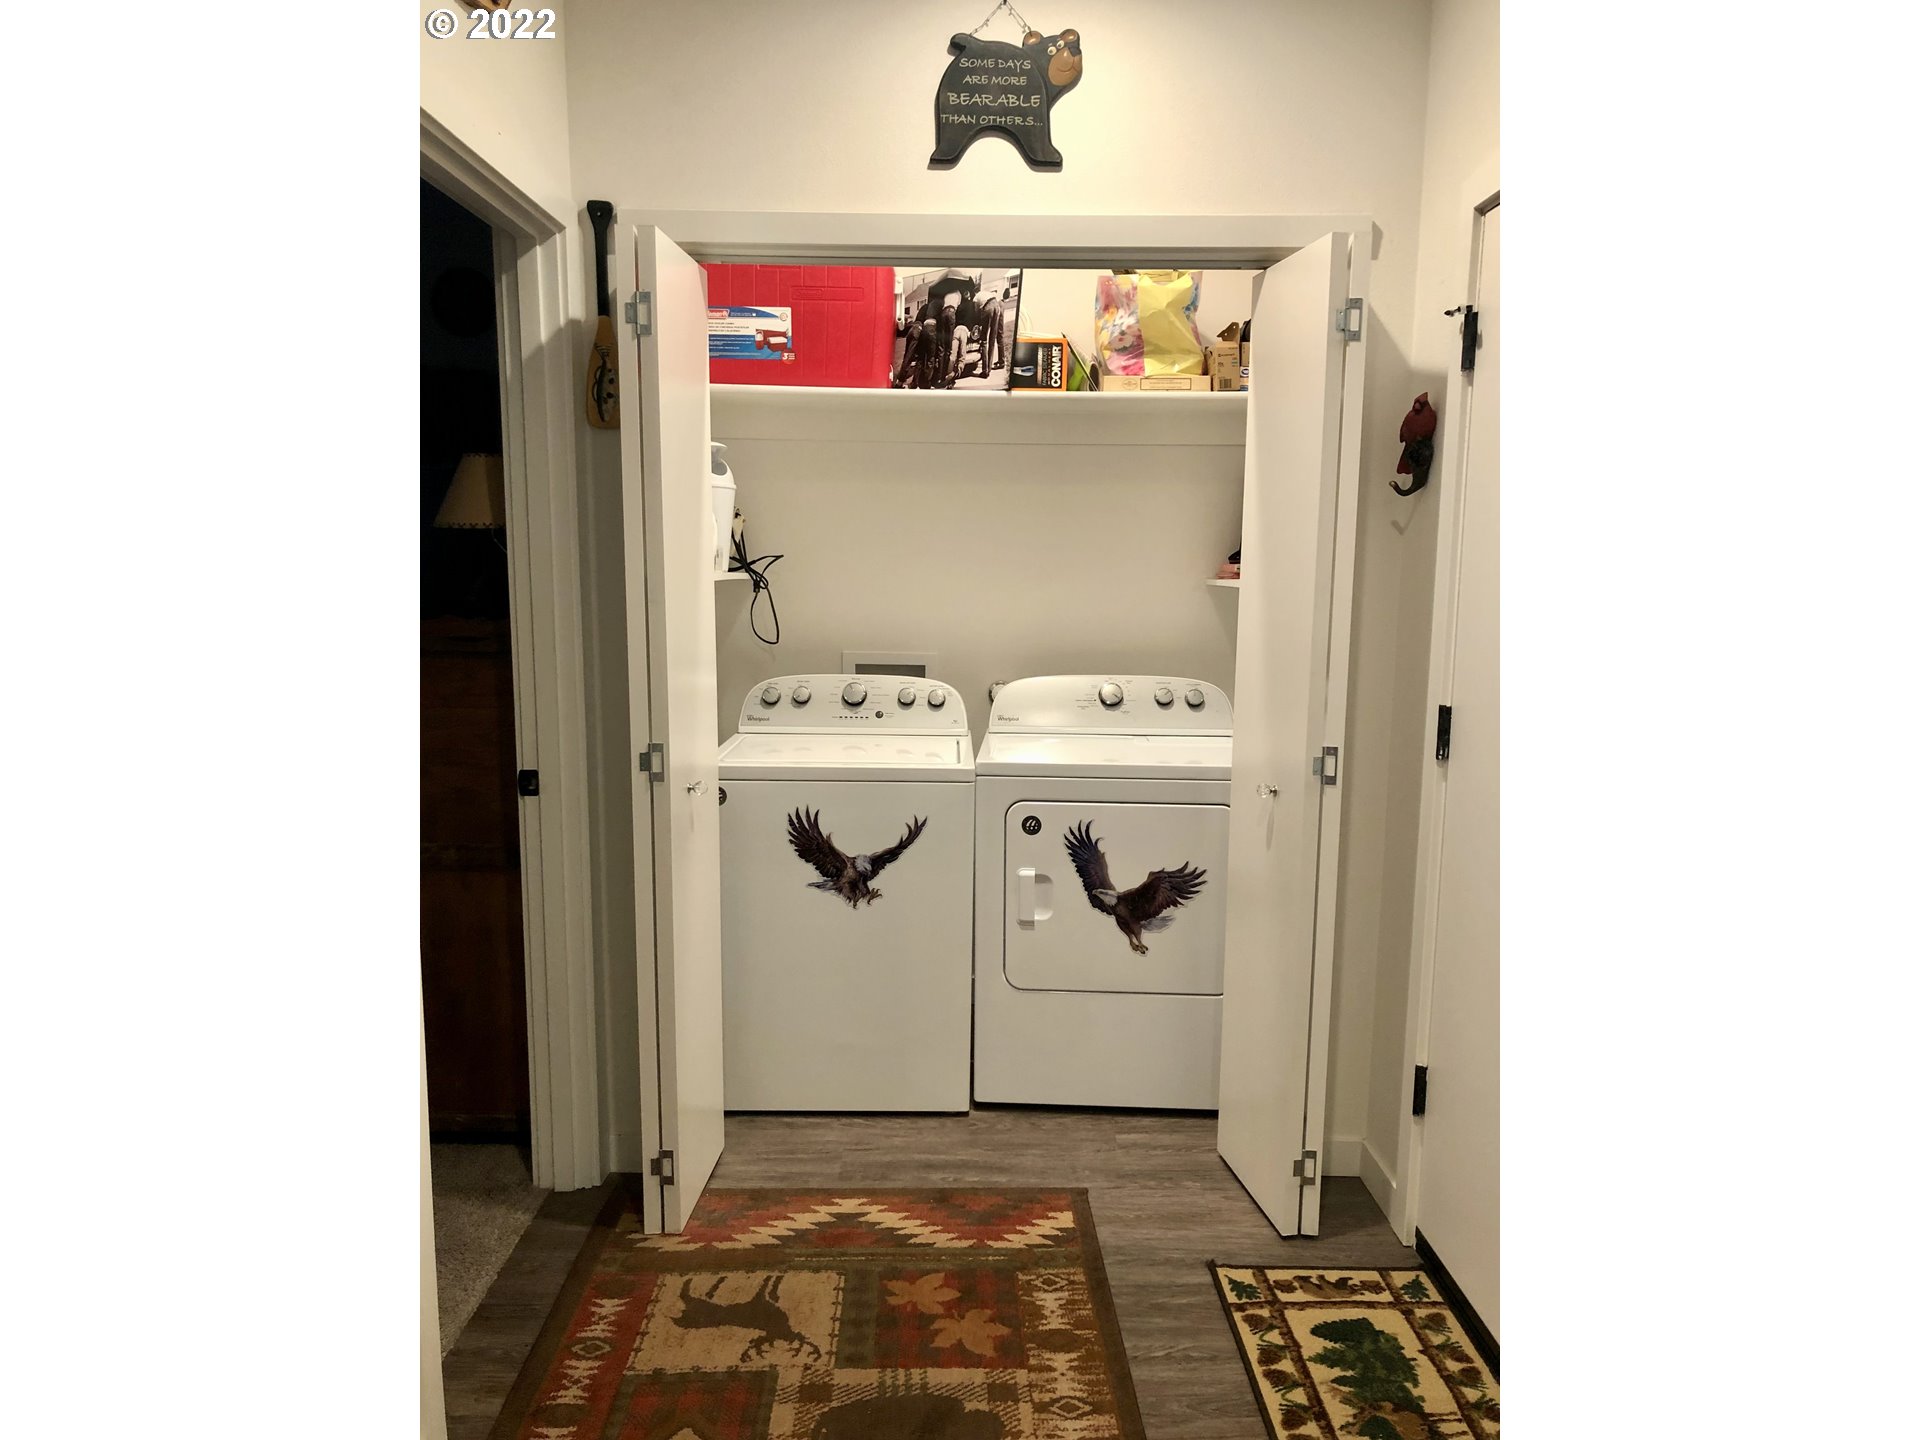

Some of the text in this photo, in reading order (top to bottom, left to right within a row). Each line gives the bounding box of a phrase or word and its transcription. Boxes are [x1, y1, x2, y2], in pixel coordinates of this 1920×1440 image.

[959, 58, 1031, 72] SOME DAYS
[963, 75, 1027, 86] ARE MORE
[947, 92, 1041, 107] BEARABLE
[941, 114, 1043, 126] THAN OTHERS...
[1051, 345, 1062, 388] CONAIR
